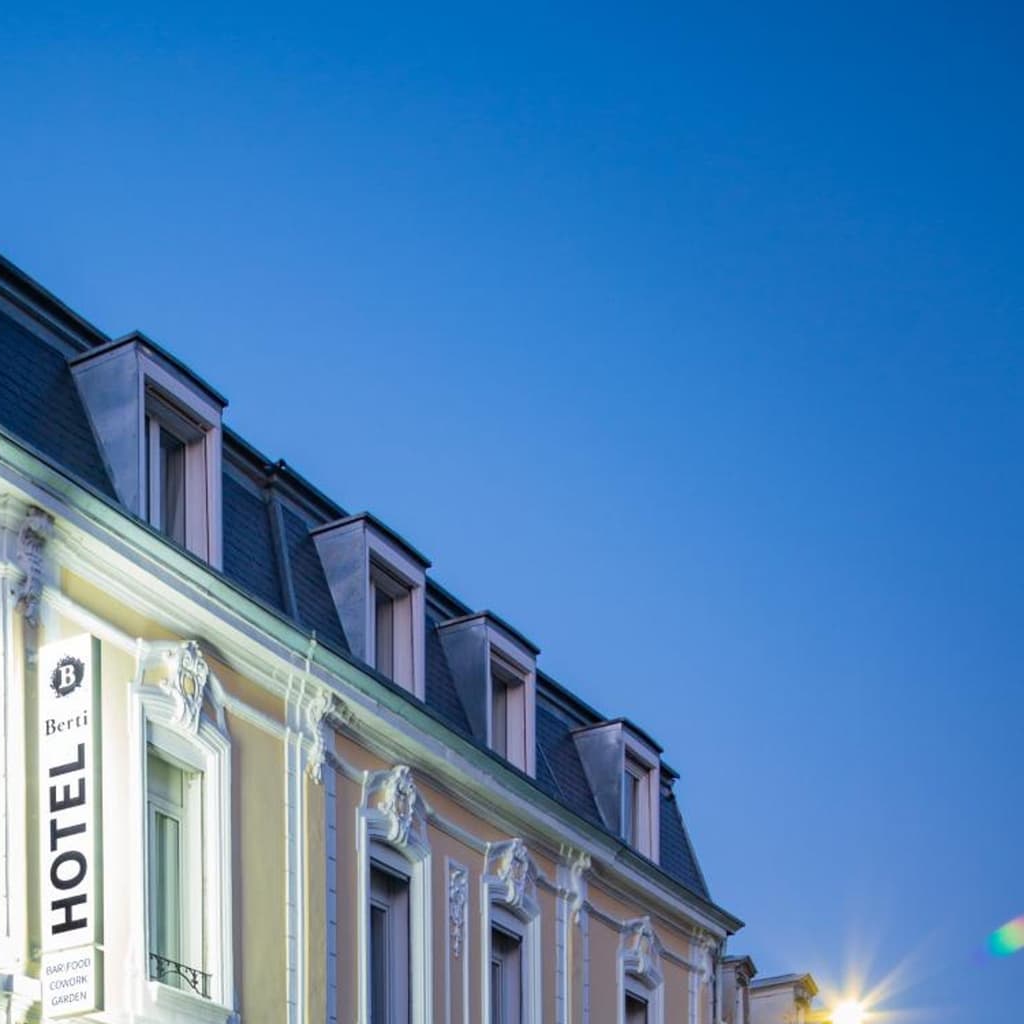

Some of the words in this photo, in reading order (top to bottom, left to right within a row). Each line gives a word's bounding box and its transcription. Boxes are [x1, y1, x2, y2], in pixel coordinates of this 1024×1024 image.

[60, 664, 76, 689] B
[45, 710, 88, 736] Berti
[49, 742, 88, 936] HOTEL
[49, 975, 87, 991] COWORK
[51, 991, 87, 1006] GARDEN
